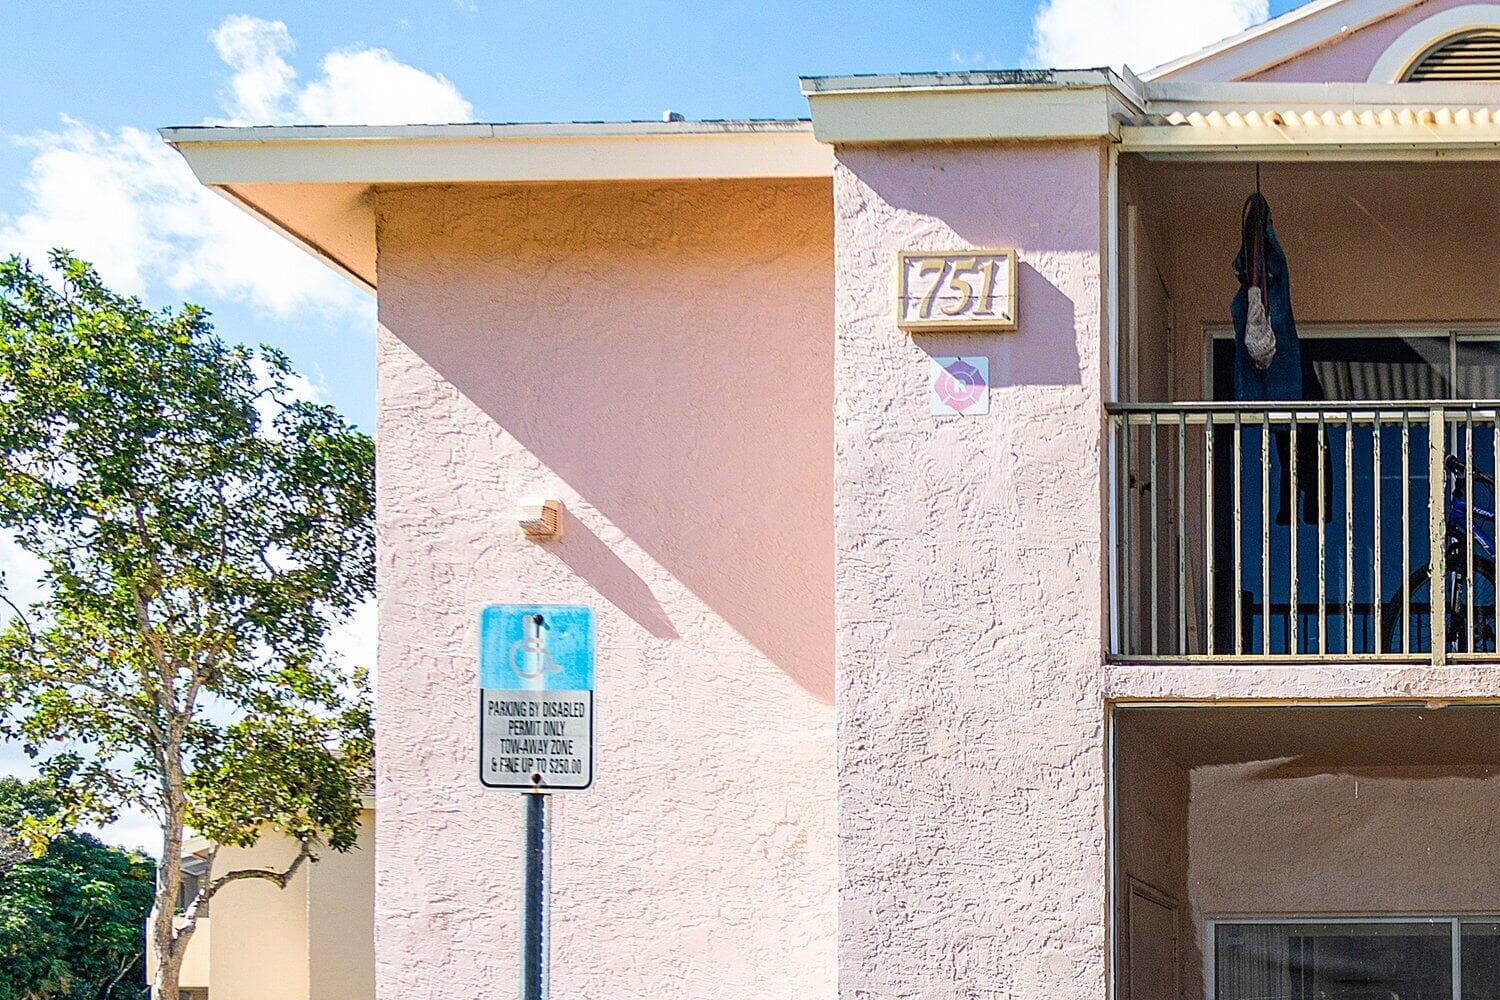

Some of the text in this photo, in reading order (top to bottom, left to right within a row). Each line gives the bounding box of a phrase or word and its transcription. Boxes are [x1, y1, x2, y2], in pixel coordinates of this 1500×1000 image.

[919, 257, 994, 319] 751
[488, 701, 585, 718] PARKING BY DISABLED
[508, 720, 566, 736] PERMIT ONLY
[500, 739, 573, 755] TOW-AWAY ZONE
[491, 757, 582, 774] & FINE UP TO $250.00
